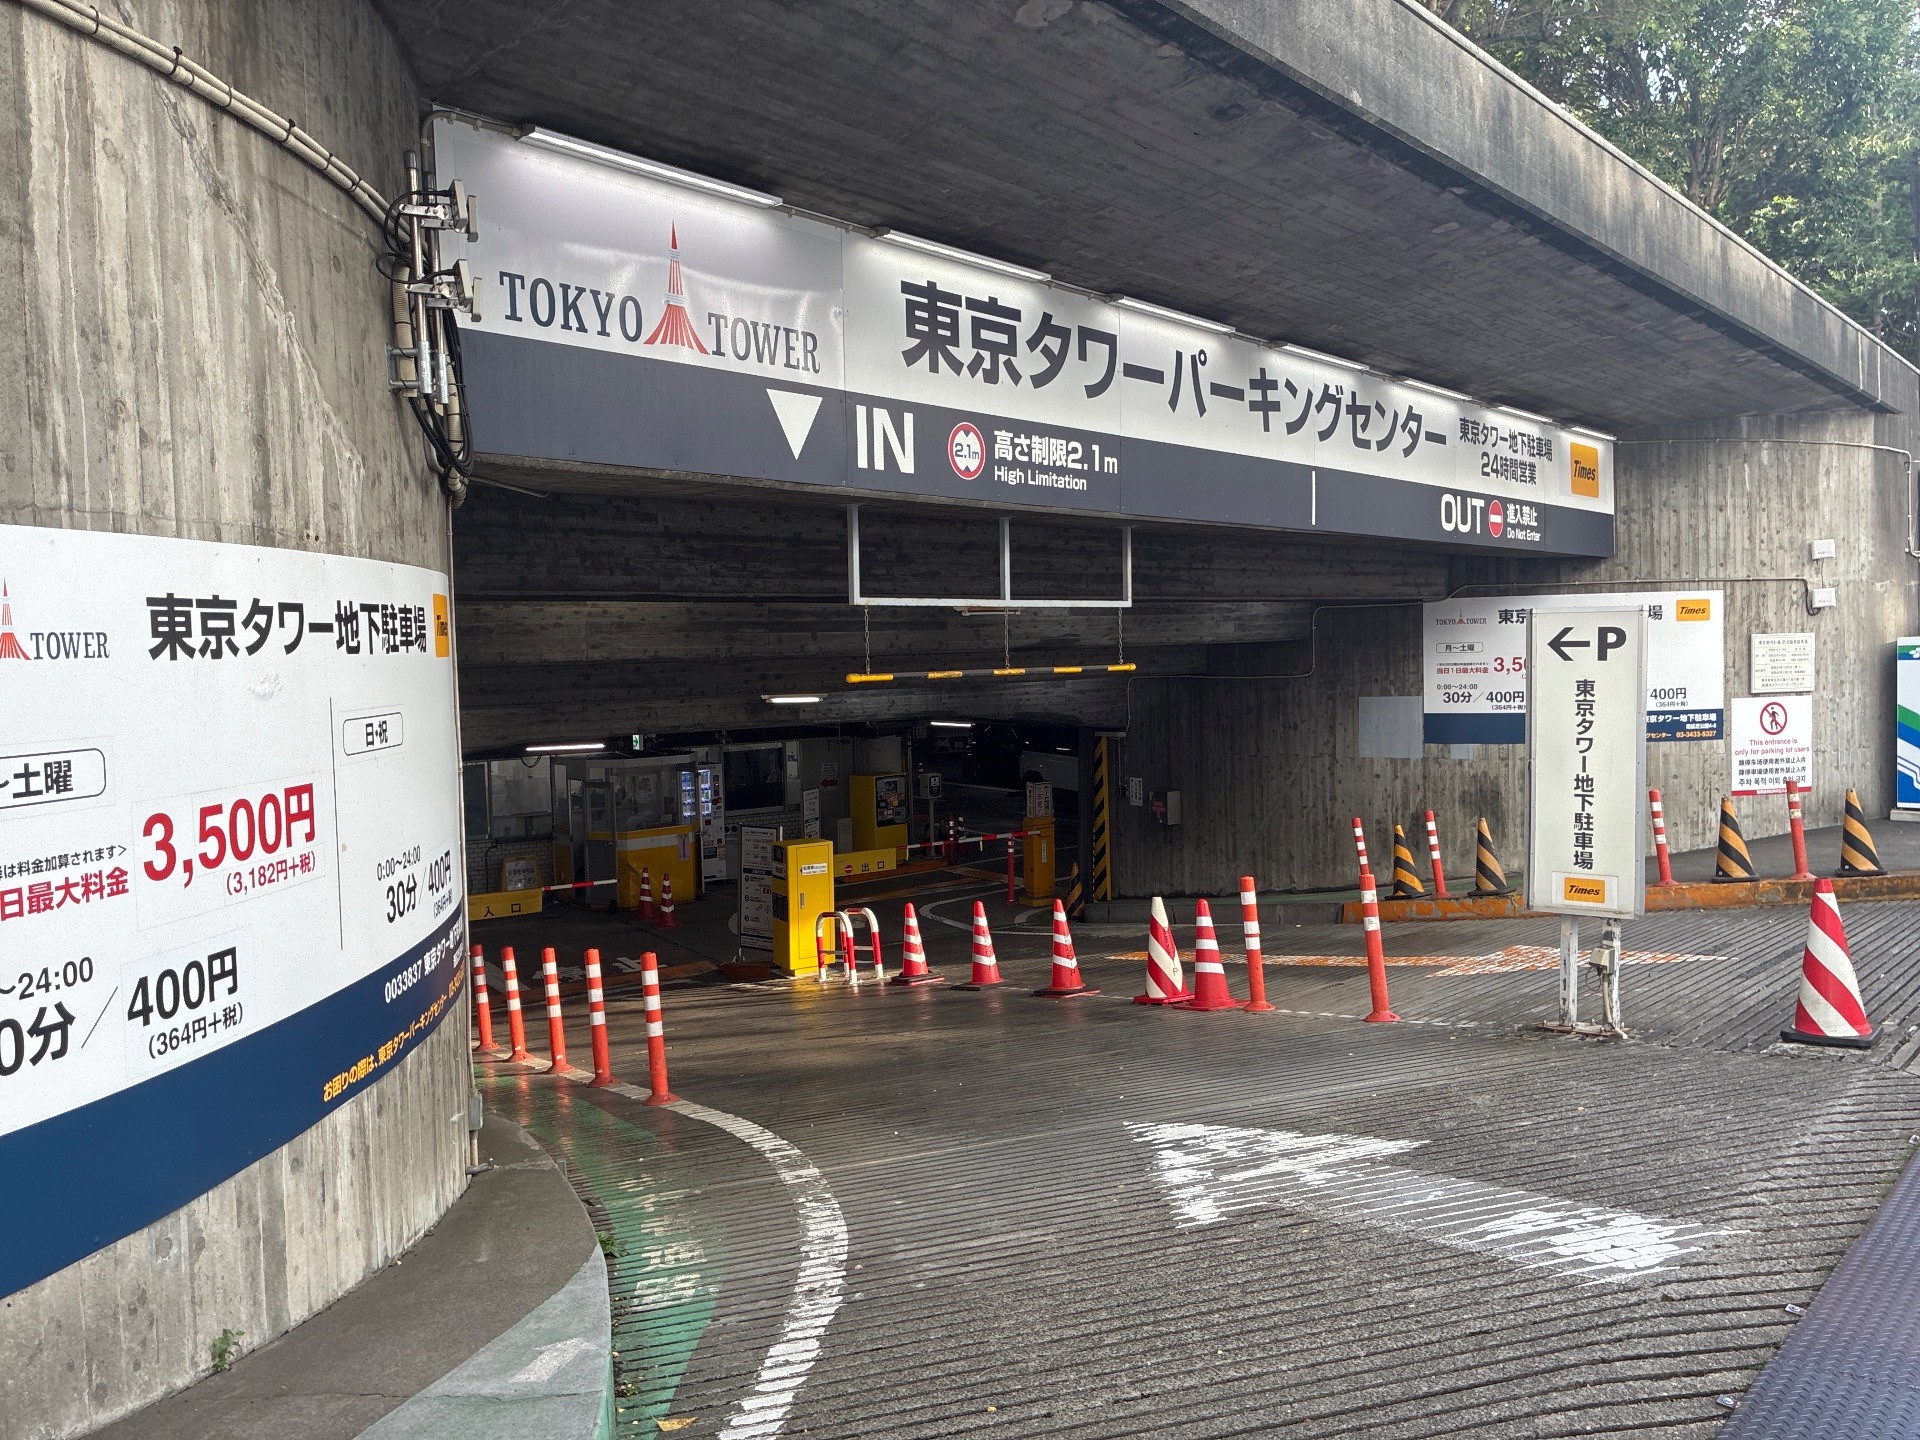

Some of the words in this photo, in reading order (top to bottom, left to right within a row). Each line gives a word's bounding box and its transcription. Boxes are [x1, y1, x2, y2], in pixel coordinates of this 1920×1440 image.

[499, 270, 644, 343] TOKYO
[707, 312, 822, 375] TOWER
[900, 280, 1447, 459] 東京タワーパーキングセンター
[856, 405, 915, 475] IN
[954, 443, 980, 460] 2.1m
[994, 430, 1118, 475] 高さ制限2.1m
[1459, 416, 1553, 463] 東京タワー地下駐車場
[994, 465, 1025, 485] High
[1028, 469, 1088, 491] Limitation
[1481, 451, 1537, 486] 24時間営業
[1573, 459, 1596, 482] Times
[1441, 493, 1485, 534] OUT
[1506, 503, 1538, 527] 進入禁止
[1507, 527, 1515, 539] Do
[1516, 529, 1526, 540] Not
[1526, 530, 1541, 541] Enter
[1436, 618, 1456, 626] TOKYO
[1679, 605, 1707, 615] Times
[146, 592, 427, 661] 東京タワー地下駐車場
[30, 631, 110, 660] TOWER
[1597, 626, 1627, 662] P
[1493, 656, 1527, 676] 3,5
[1650, 687, 1687, 700] 400円
[1760, 747, 1784, 755] parking
[1764, 738, 1791, 746] entrance
[1573, 678, 1596, 871] 東京タワー地下駐車場
[142, 783, 316, 890] 3,500円
[0, 845, 127, 880] は料金加算されます>
[1567, 884, 1602, 897] Times
[483, 902, 521, 918] 入口
[384, 959, 422, 1004] 0033837
